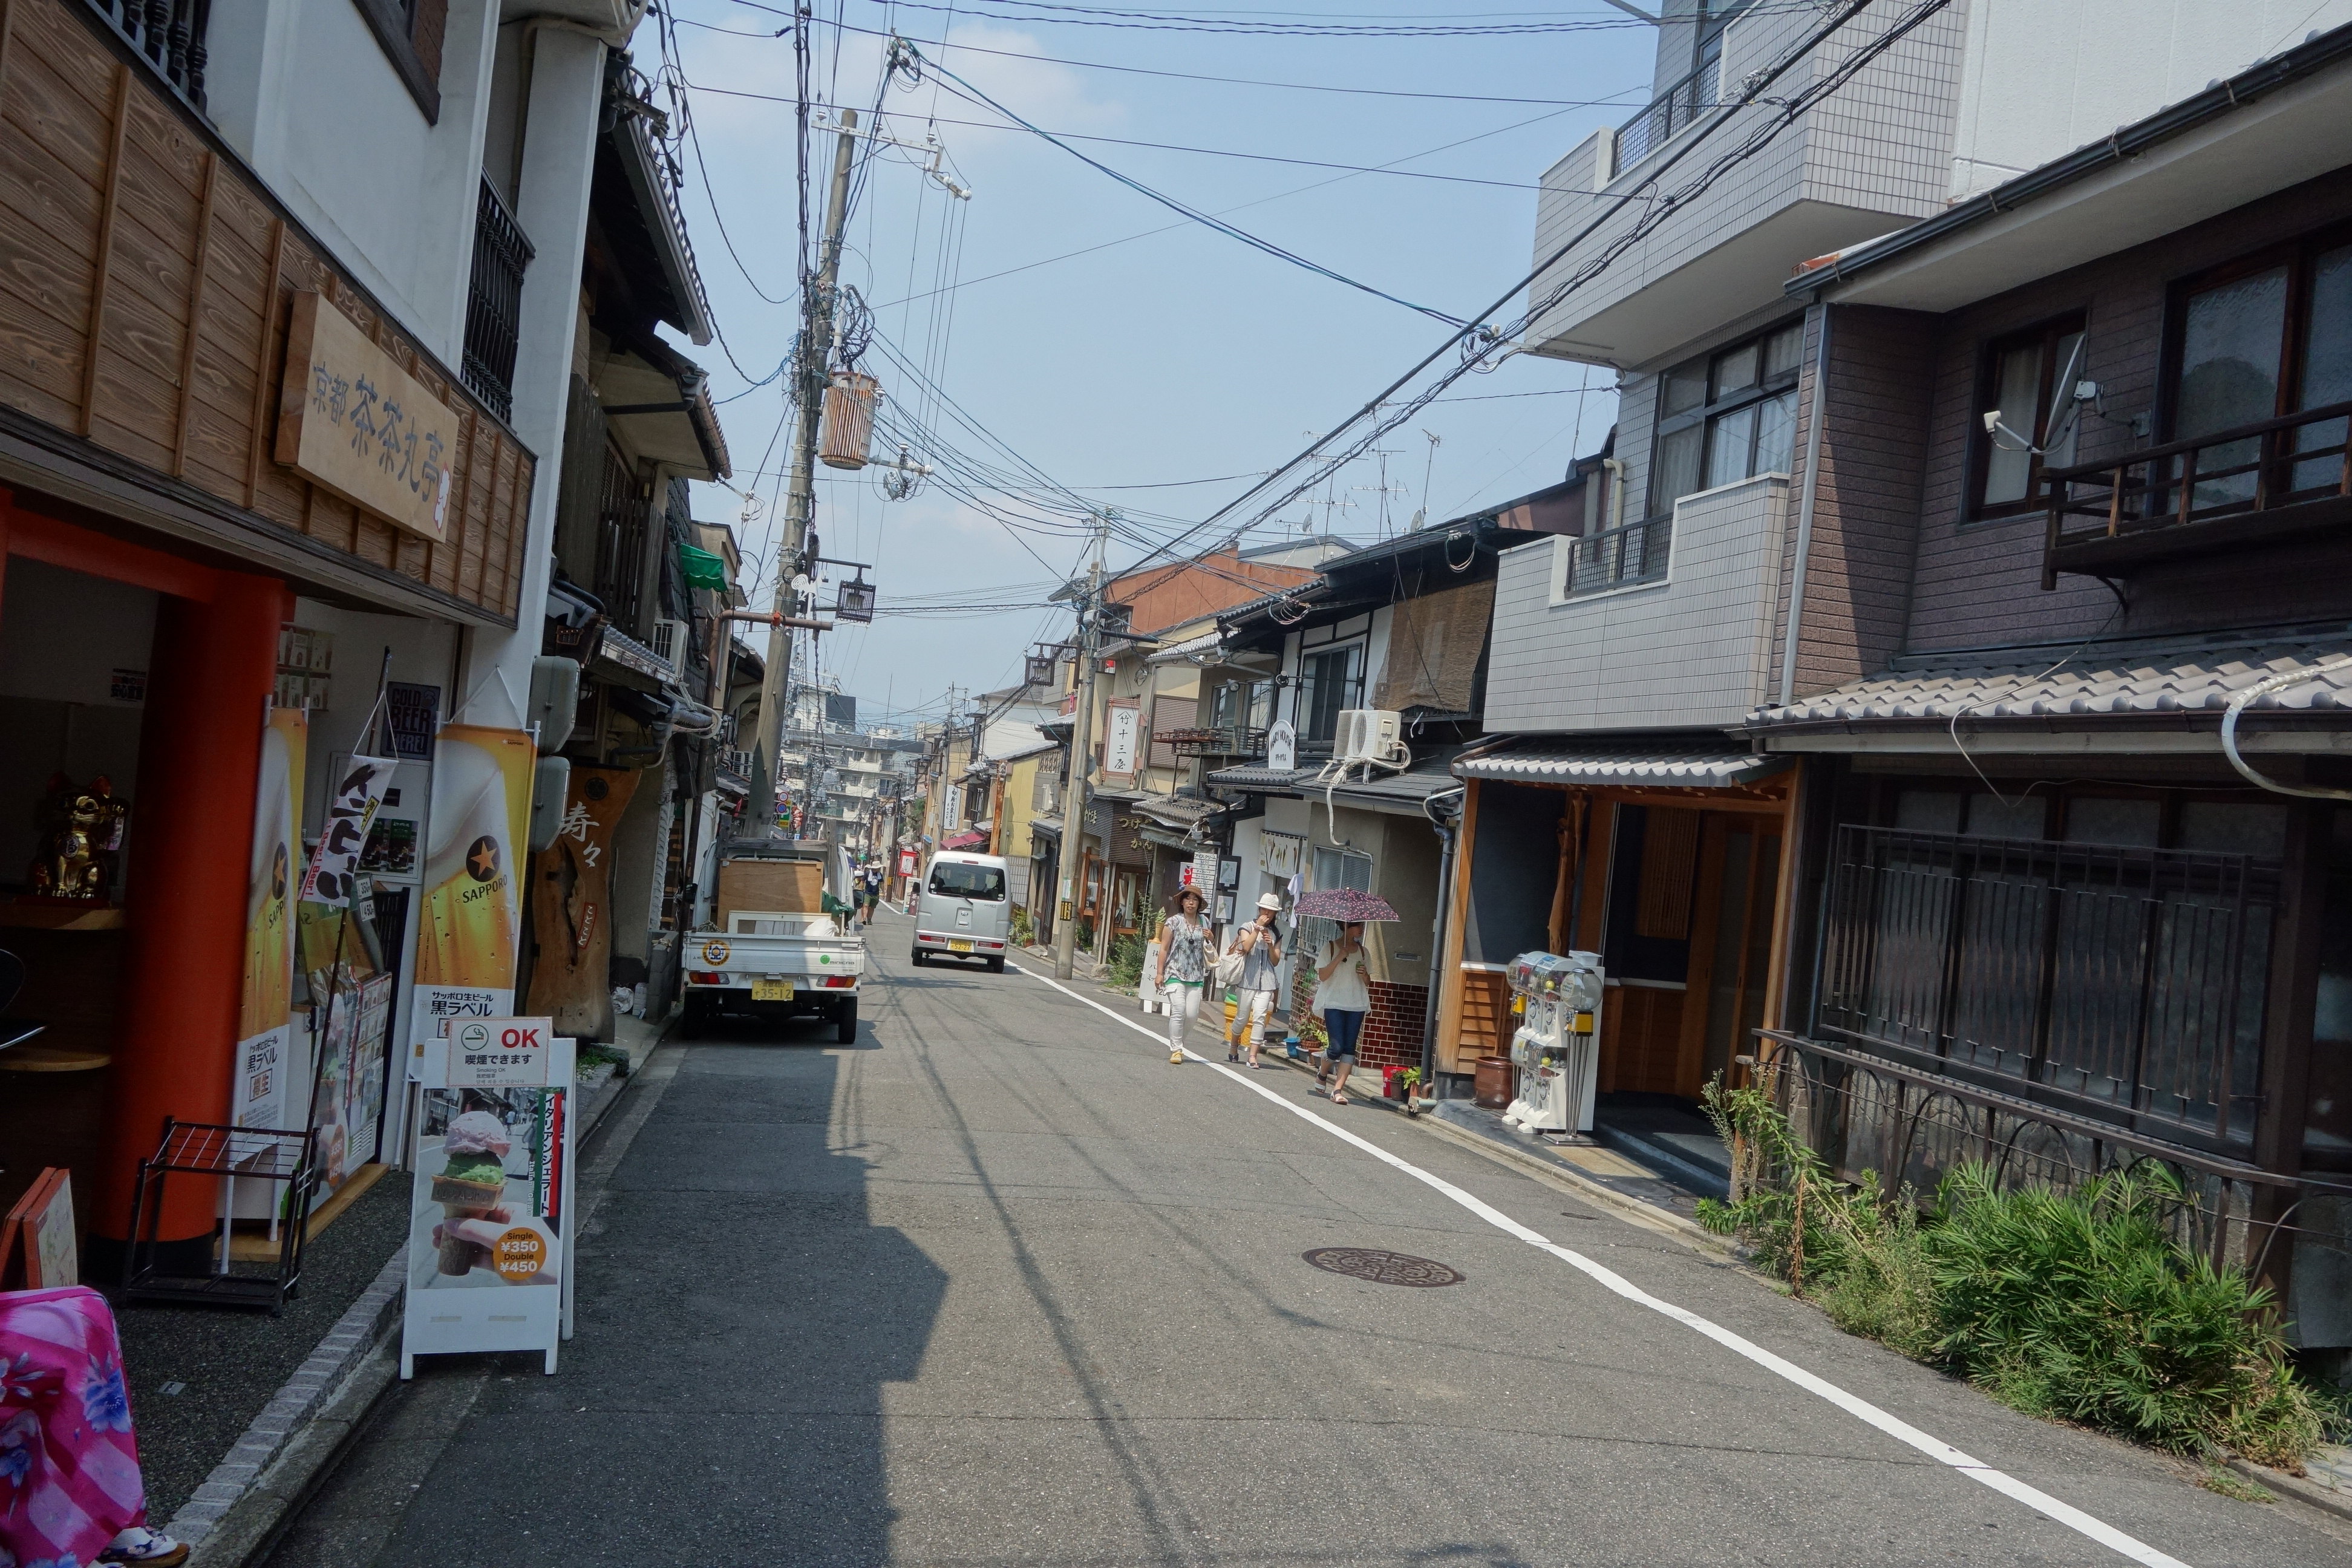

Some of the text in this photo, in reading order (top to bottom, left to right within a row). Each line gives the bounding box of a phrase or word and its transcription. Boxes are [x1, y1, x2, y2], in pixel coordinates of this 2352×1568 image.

[392, 688, 422, 707] COLD
[390, 705, 431, 733] BEER
[305, 866, 321, 896] Beer!
[462, 874, 508, 904] SAPPORO
[432, 991, 494, 1002] サッポロ生ビール
[760, 988, 791, 999] 35-12
[430, 1000, 493, 1017] 黒ラベル
[501, 1028, 540, 1048] OK
[246, 1047, 278, 1074] 黒ラベル
[465, 1054, 532, 1065] 喫煙できます
[501, 1241, 538, 1252] ¥350
[500, 1261, 538, 1273] ¥450
